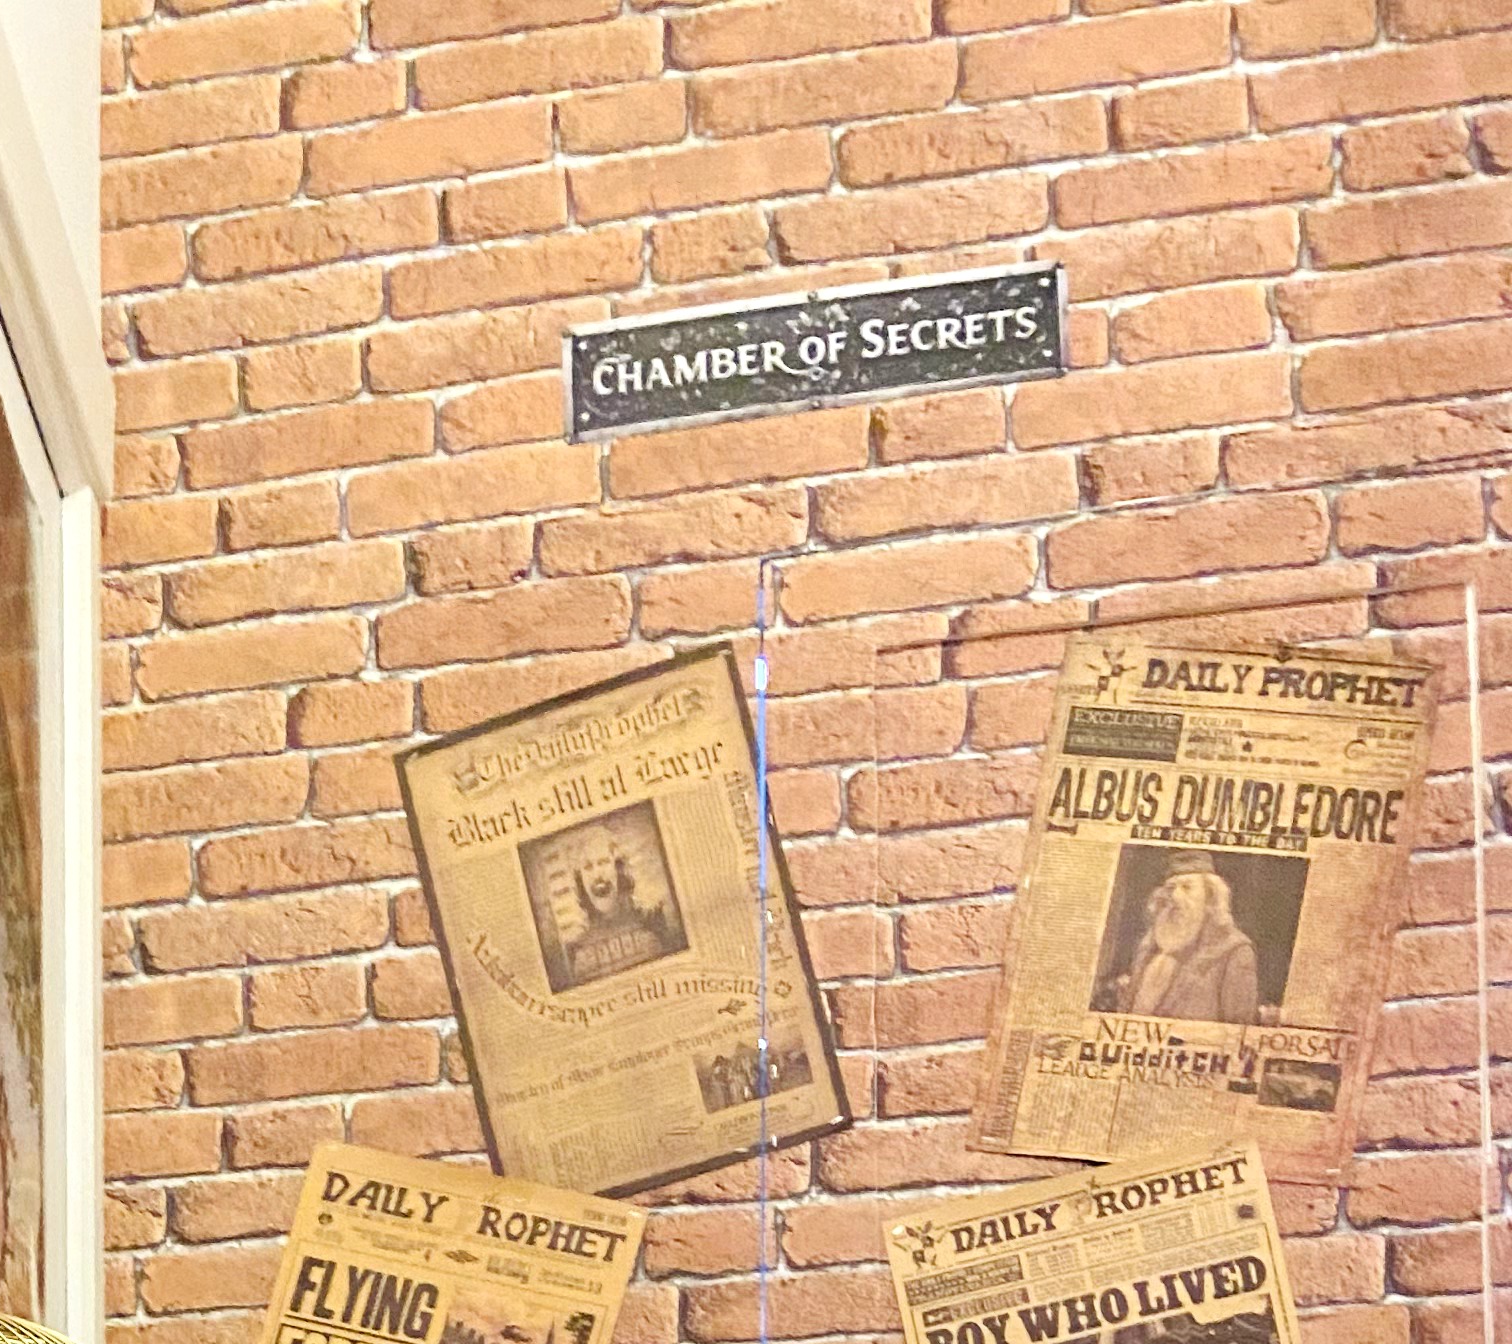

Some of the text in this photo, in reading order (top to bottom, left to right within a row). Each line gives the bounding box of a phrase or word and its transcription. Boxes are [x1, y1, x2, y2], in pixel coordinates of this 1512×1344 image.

[592, 306, 1037, 397] CHAMBER OF SECRETS
[1142, 658, 1425, 708] DAILY PROPHET
[448, 742, 724, 848] Black still at Large
[1048, 766, 1404, 845] ALBUS DUMBLEDORE
[1096, 1017, 1174, 1044] NEW
[1258, 1032, 1306, 1055] FOR
[322, 1170, 450, 1223] DAILY
[950, 1202, 1061, 1253] DAILY
[289, 1256, 440, 1341] FLYING
[1017, 1288, 1130, 1343] WHO
[1133, 1255, 1267, 1317] LIVED
